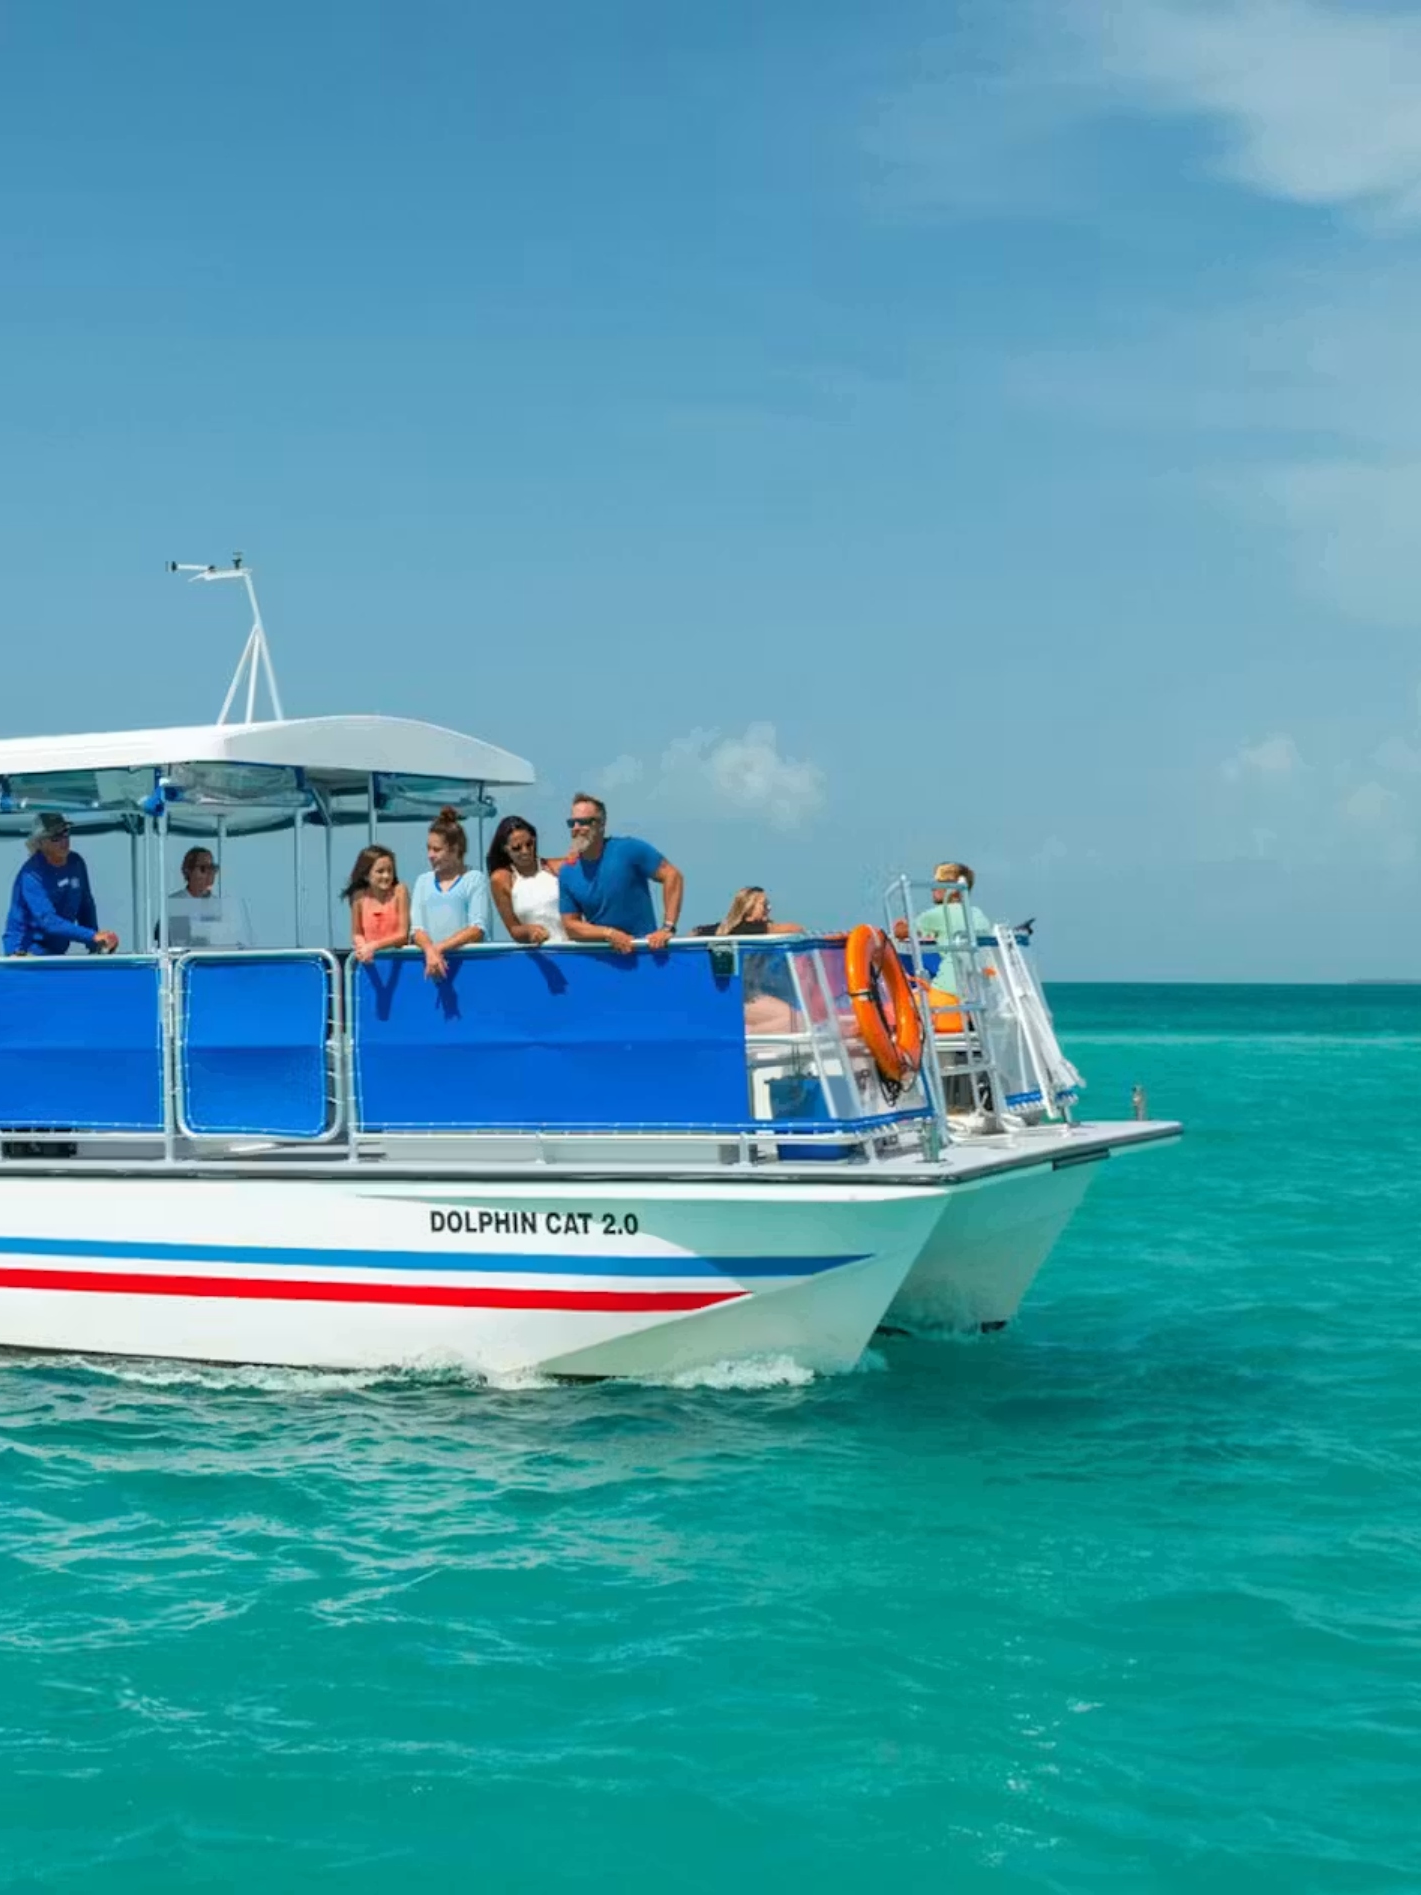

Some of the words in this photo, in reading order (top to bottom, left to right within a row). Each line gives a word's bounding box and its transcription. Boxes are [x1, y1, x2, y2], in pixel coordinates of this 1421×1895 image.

[430, 1210, 538, 1234] DOLPHIN
[545, 1211, 593, 1235] CAT
[602, 1212, 639, 1236] 2.0
